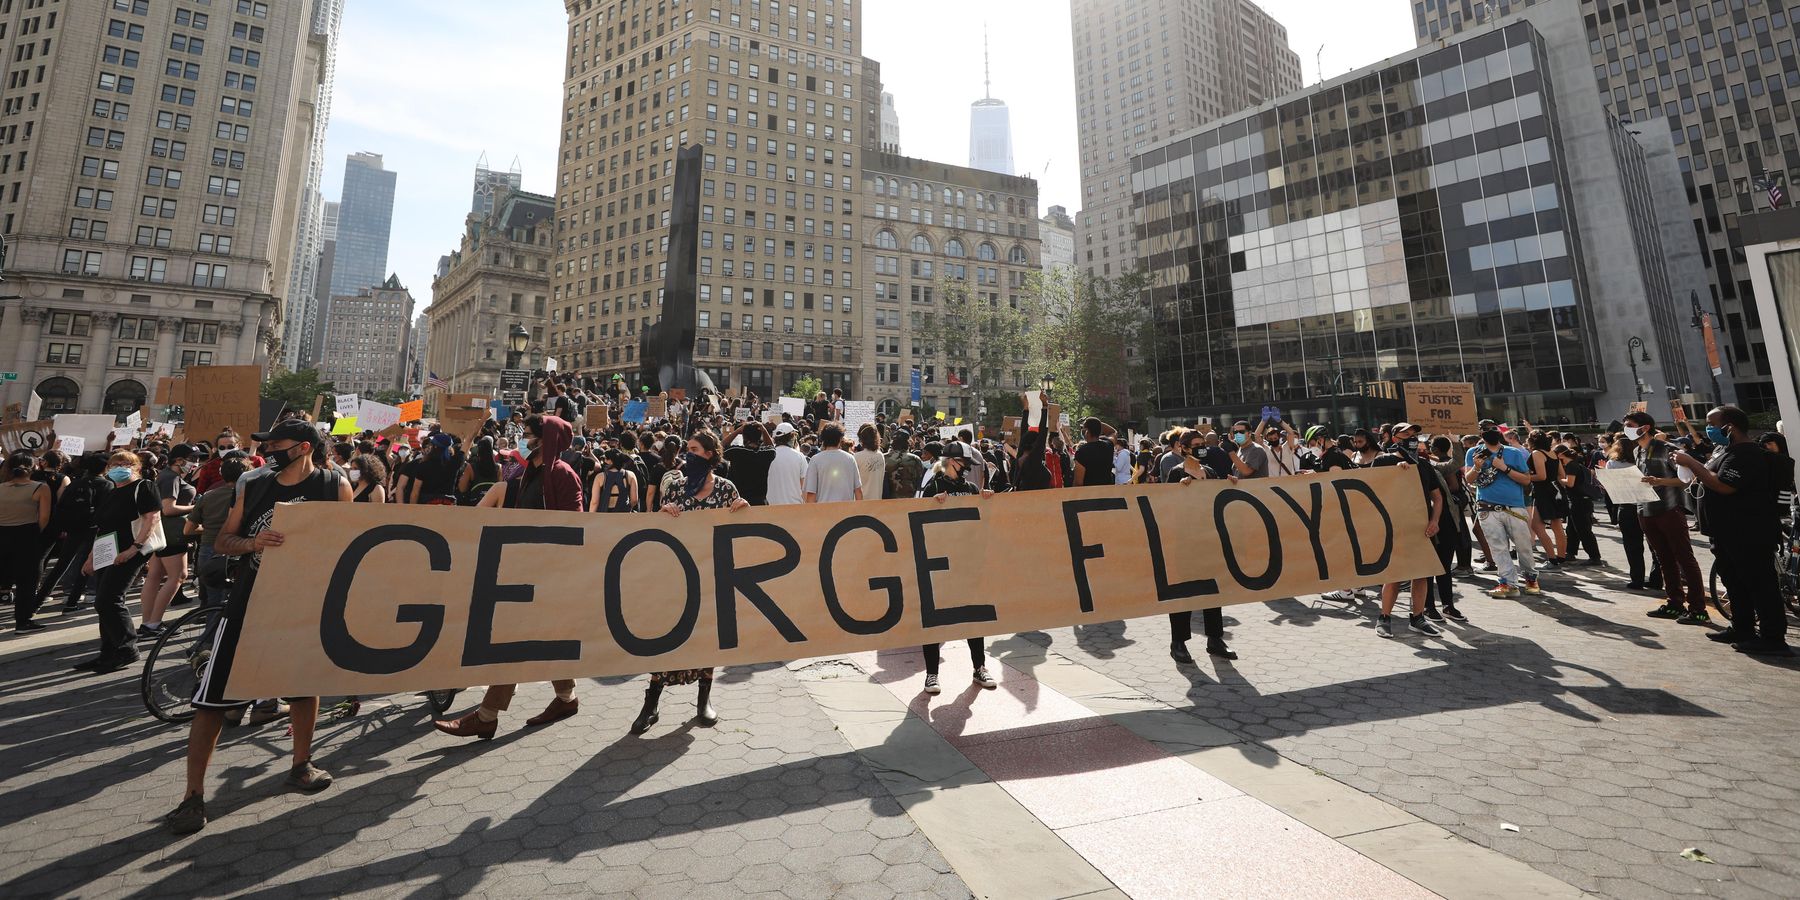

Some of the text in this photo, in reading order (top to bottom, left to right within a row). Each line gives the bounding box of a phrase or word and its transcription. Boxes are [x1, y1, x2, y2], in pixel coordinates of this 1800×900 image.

[191, 370, 240, 384] BLACK
[191, 388, 241, 407] LIVES
[1418, 394, 1463, 405] JUSTICE
[189, 408, 257, 429] MATTER
[1430, 409, 1451, 419] FOR
[319, 479, 1394, 675] GEORGE FLOYD
